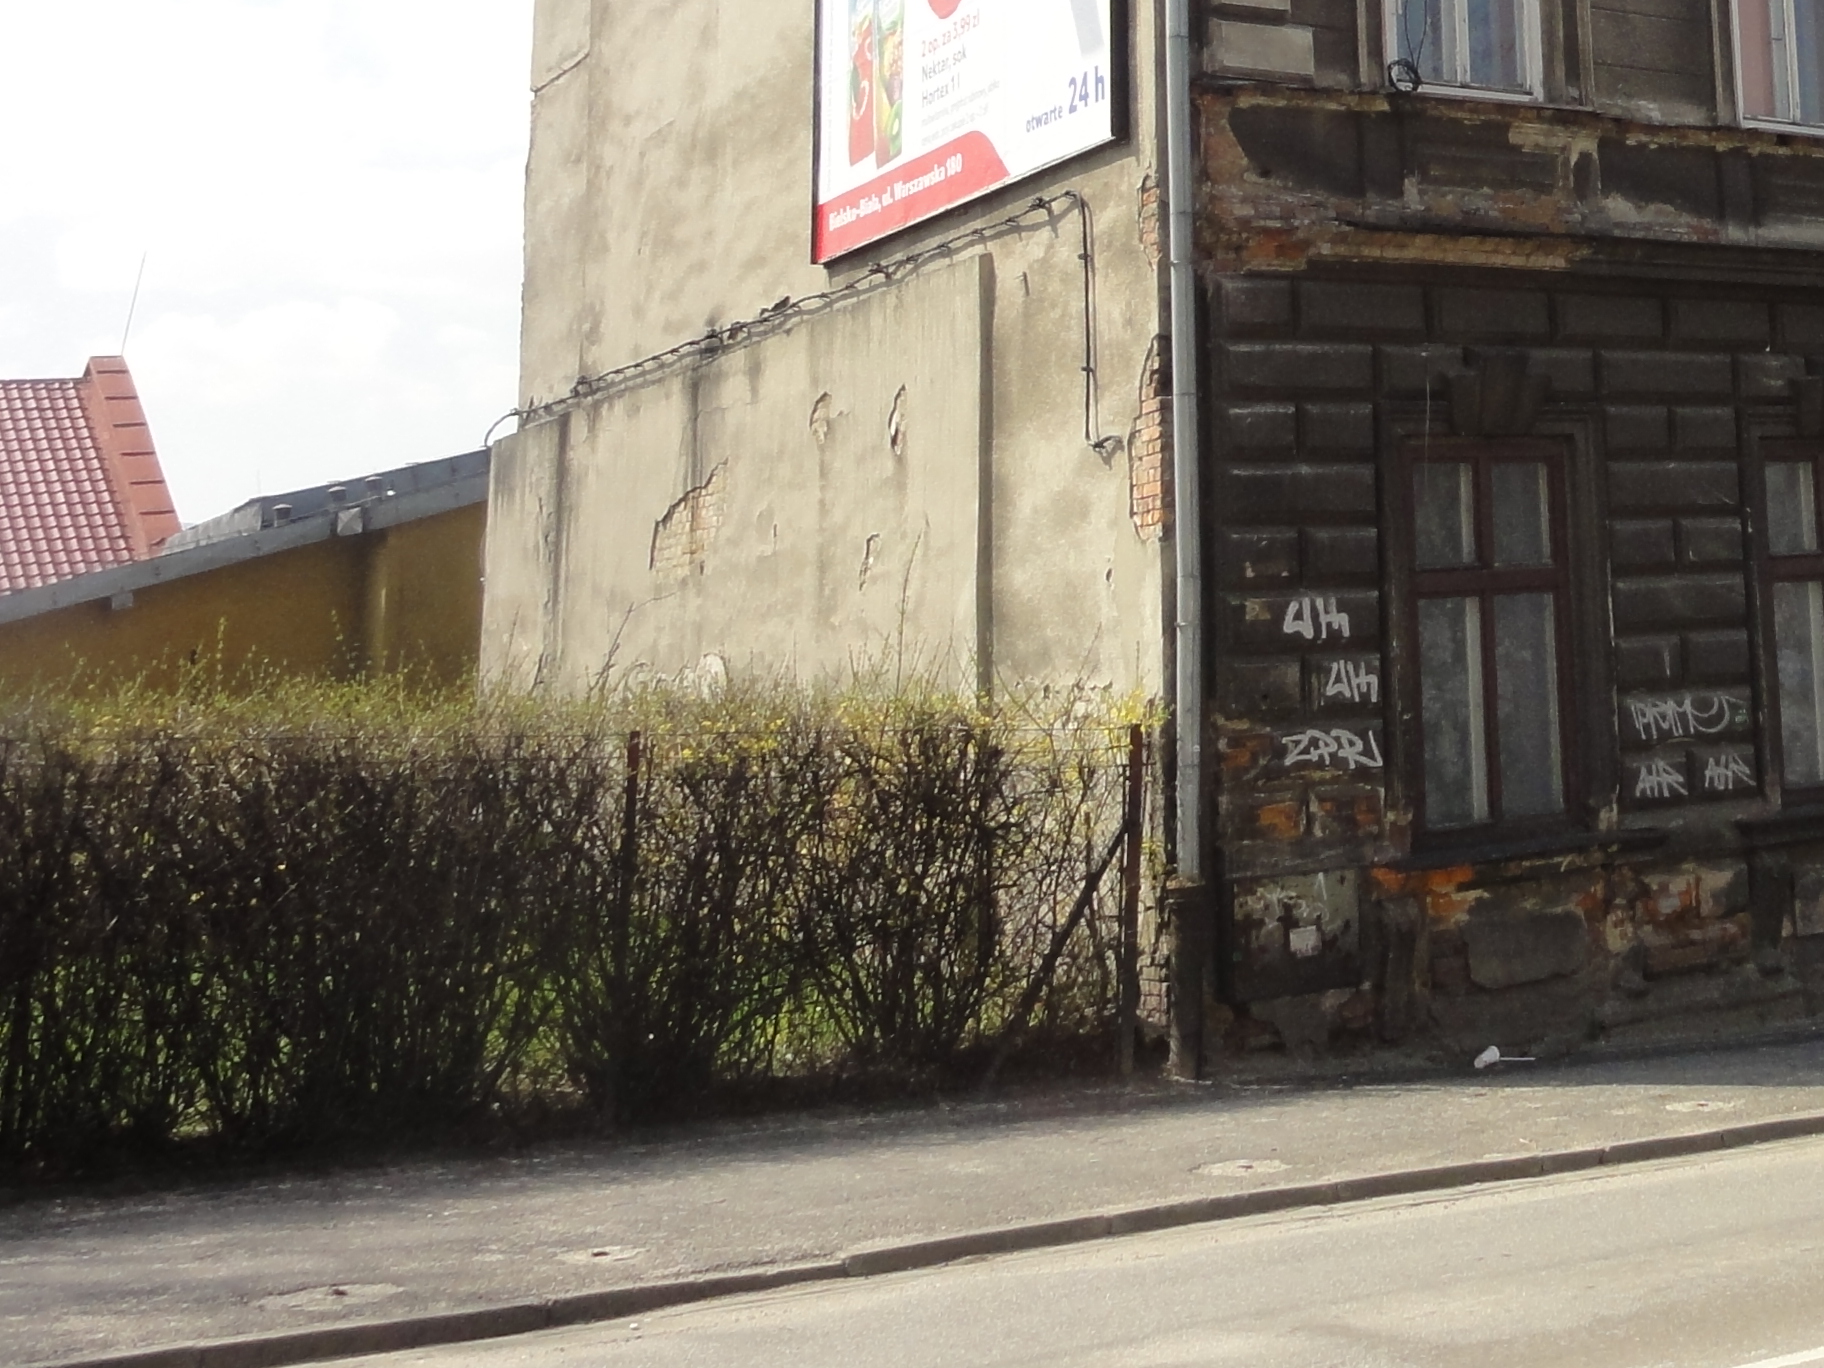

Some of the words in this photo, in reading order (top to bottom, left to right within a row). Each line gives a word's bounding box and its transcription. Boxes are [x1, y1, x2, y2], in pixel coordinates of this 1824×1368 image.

[942, 30, 951, 46] za
[953, 14, 970, 40] 3,99
[922, 57, 951, 83] Nektar,
[953, 42, 967, 66] sok
[921, 82, 949, 109] Hortex
[1025, 104, 1063, 133] otwarte
[1068, 73, 1090, 116] 24
[1092, 65, 1106, 103] h
[894, 163, 946, 201] Warszawska
